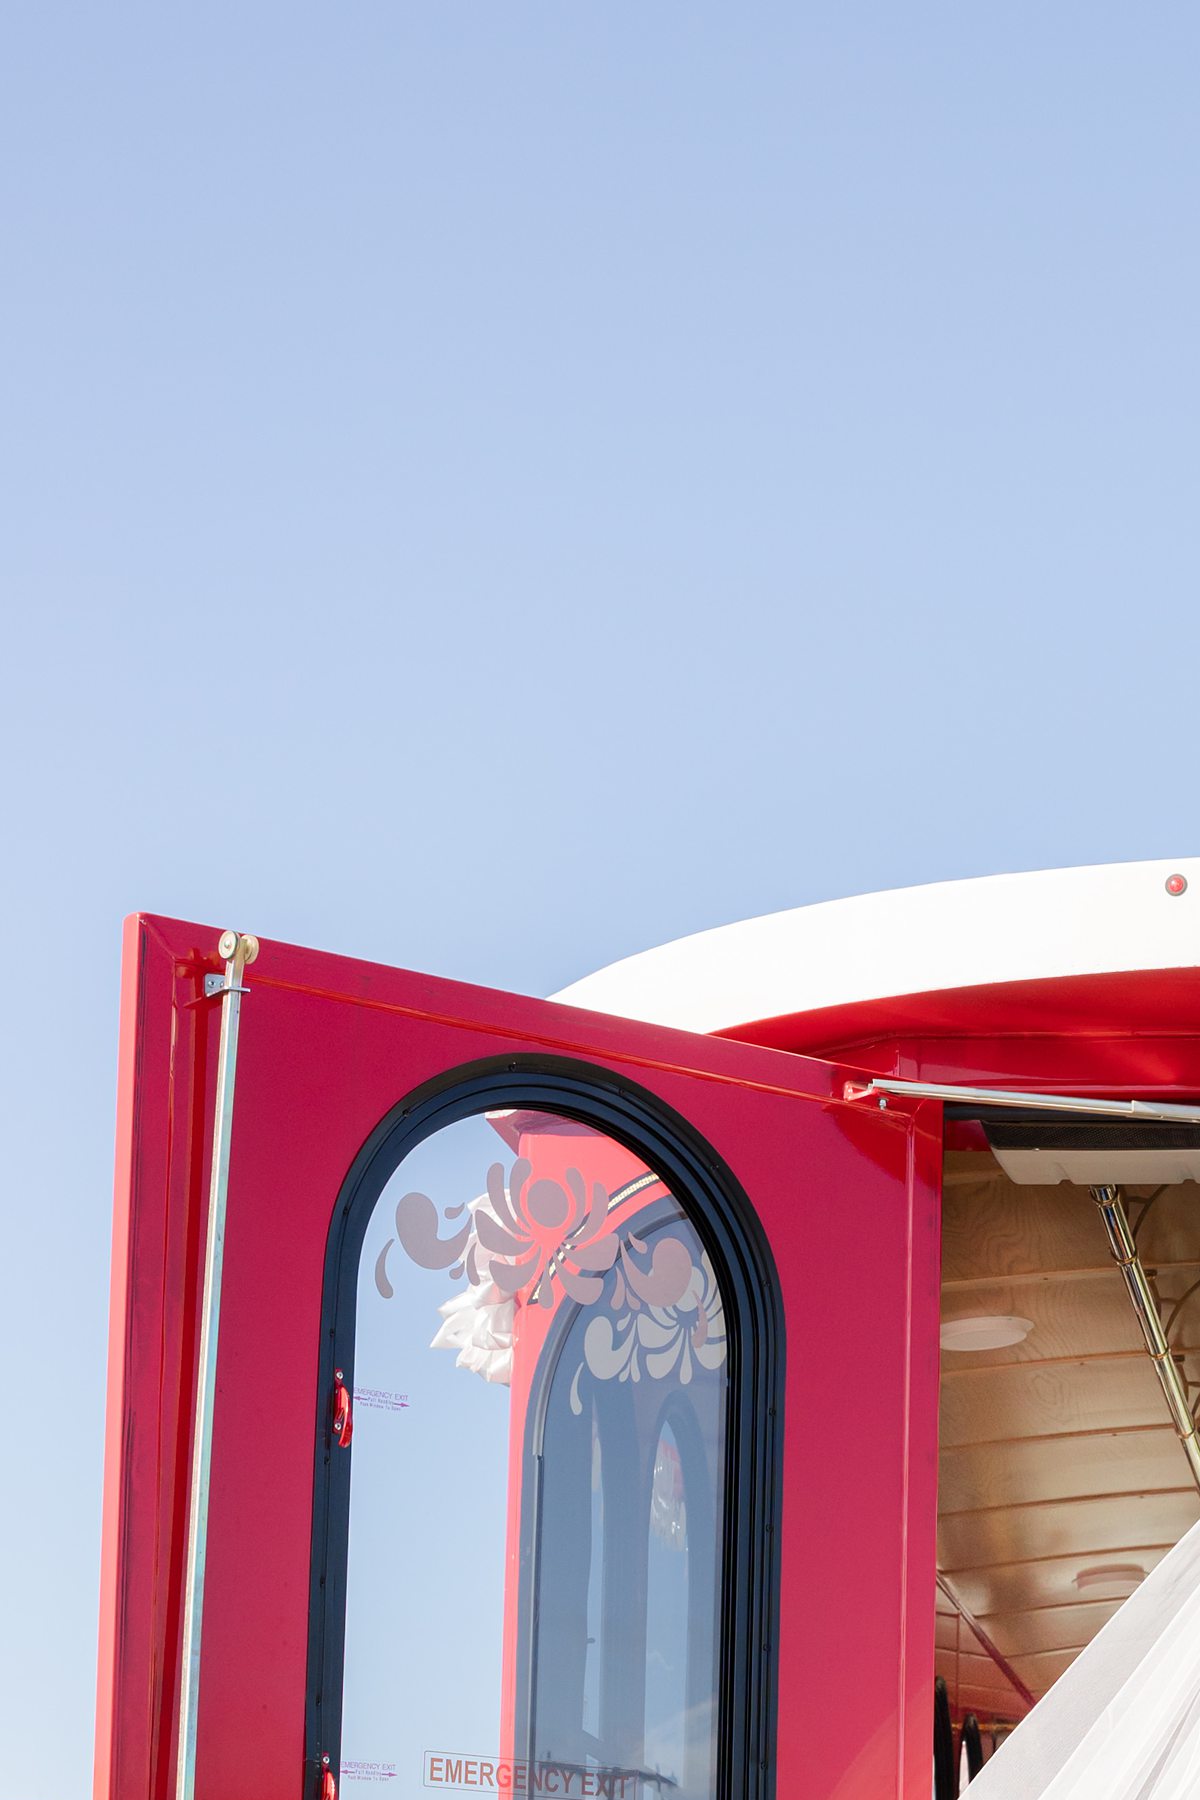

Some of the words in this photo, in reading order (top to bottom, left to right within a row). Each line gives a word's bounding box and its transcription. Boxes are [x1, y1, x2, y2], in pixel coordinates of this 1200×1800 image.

[354, 1387, 392, 1399] EMERGENCY
[394, 1393, 408, 1401] EXIT
[341, 1761, 380, 1770] EMERGENCY
[382, 1763, 396, 1771] EXIT
[429, 1757, 575, 1793] EMERGENCY
[581, 1772, 630, 1799] EXIT
